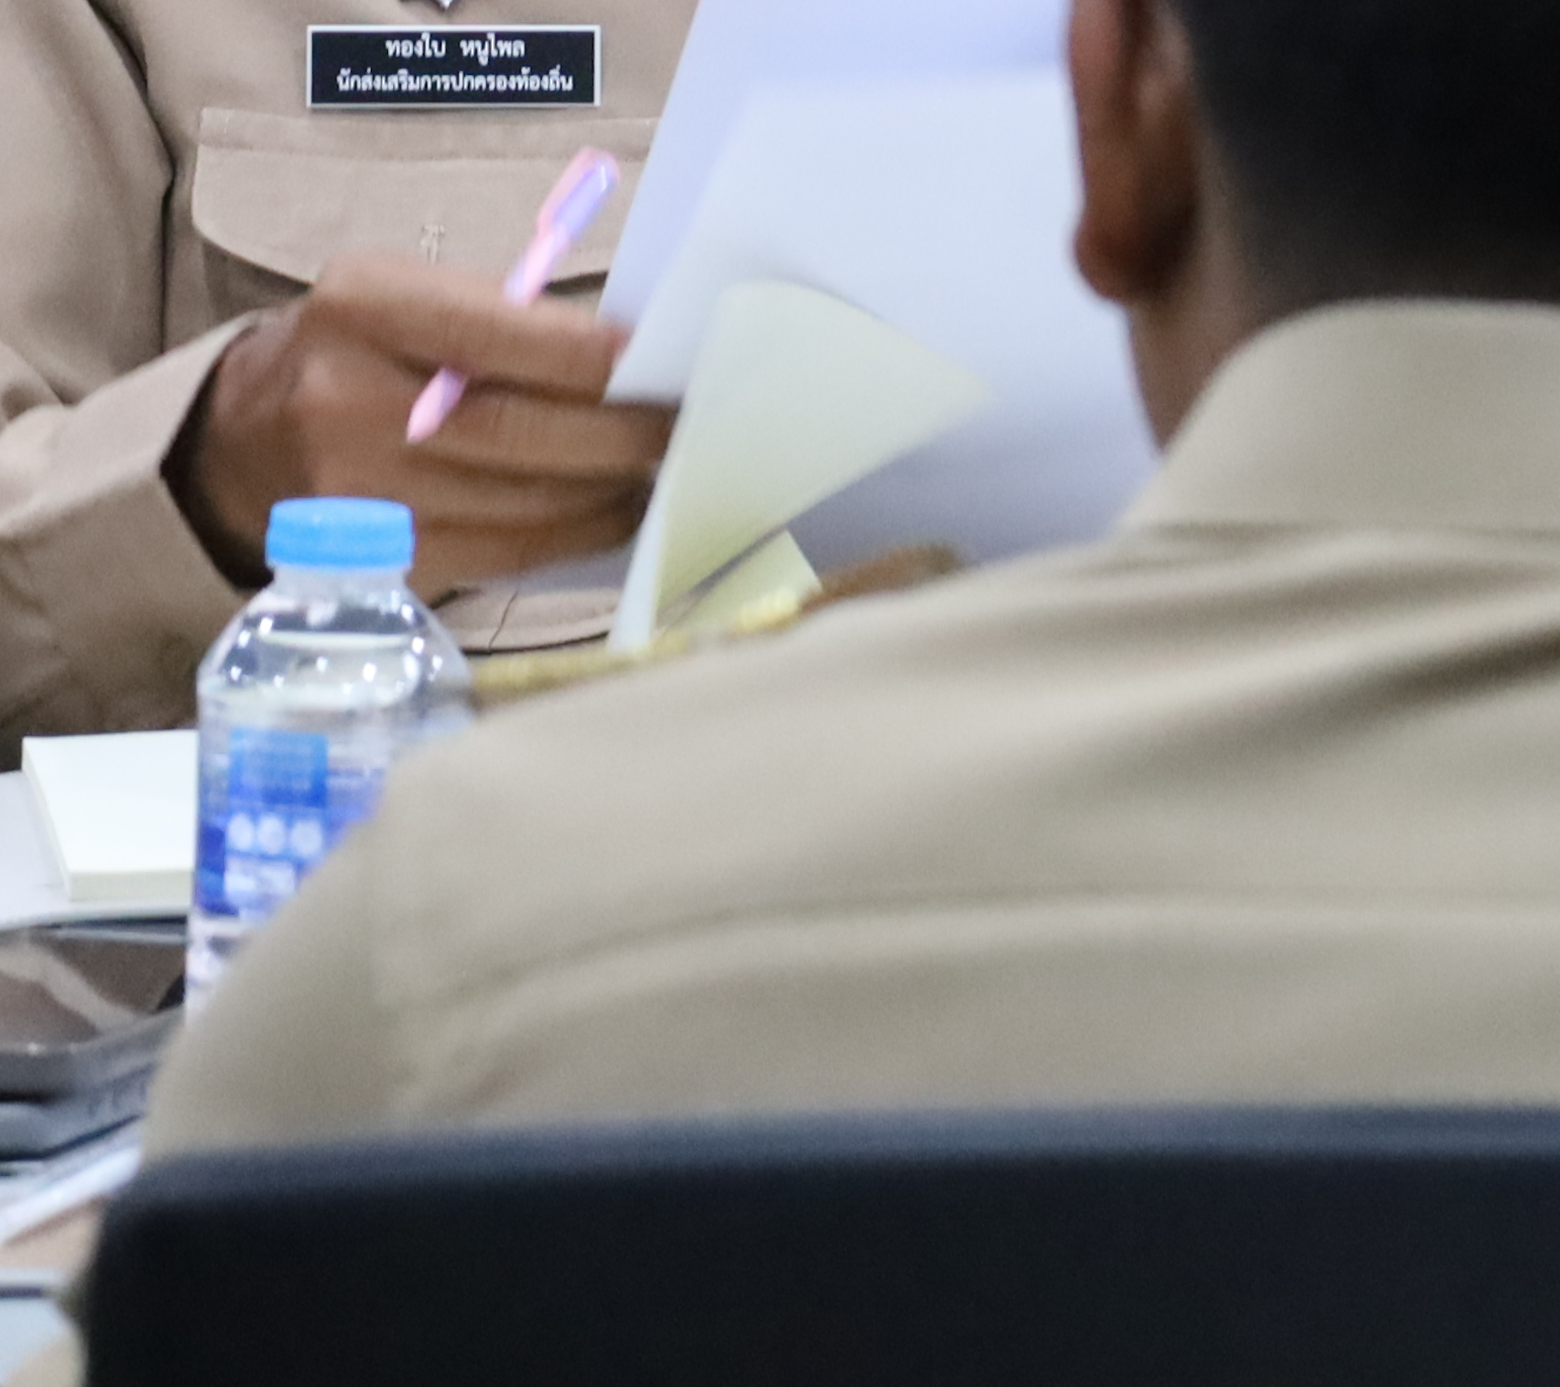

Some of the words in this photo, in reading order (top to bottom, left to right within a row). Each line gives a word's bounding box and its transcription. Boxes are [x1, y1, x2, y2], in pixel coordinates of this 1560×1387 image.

[385, 32, 447, 58] ทองใบ
[459, 32, 526, 67] หนูไพล
[336, 64, 574, 93] นักส่งเสริมการปกครองท้องถิ่น
